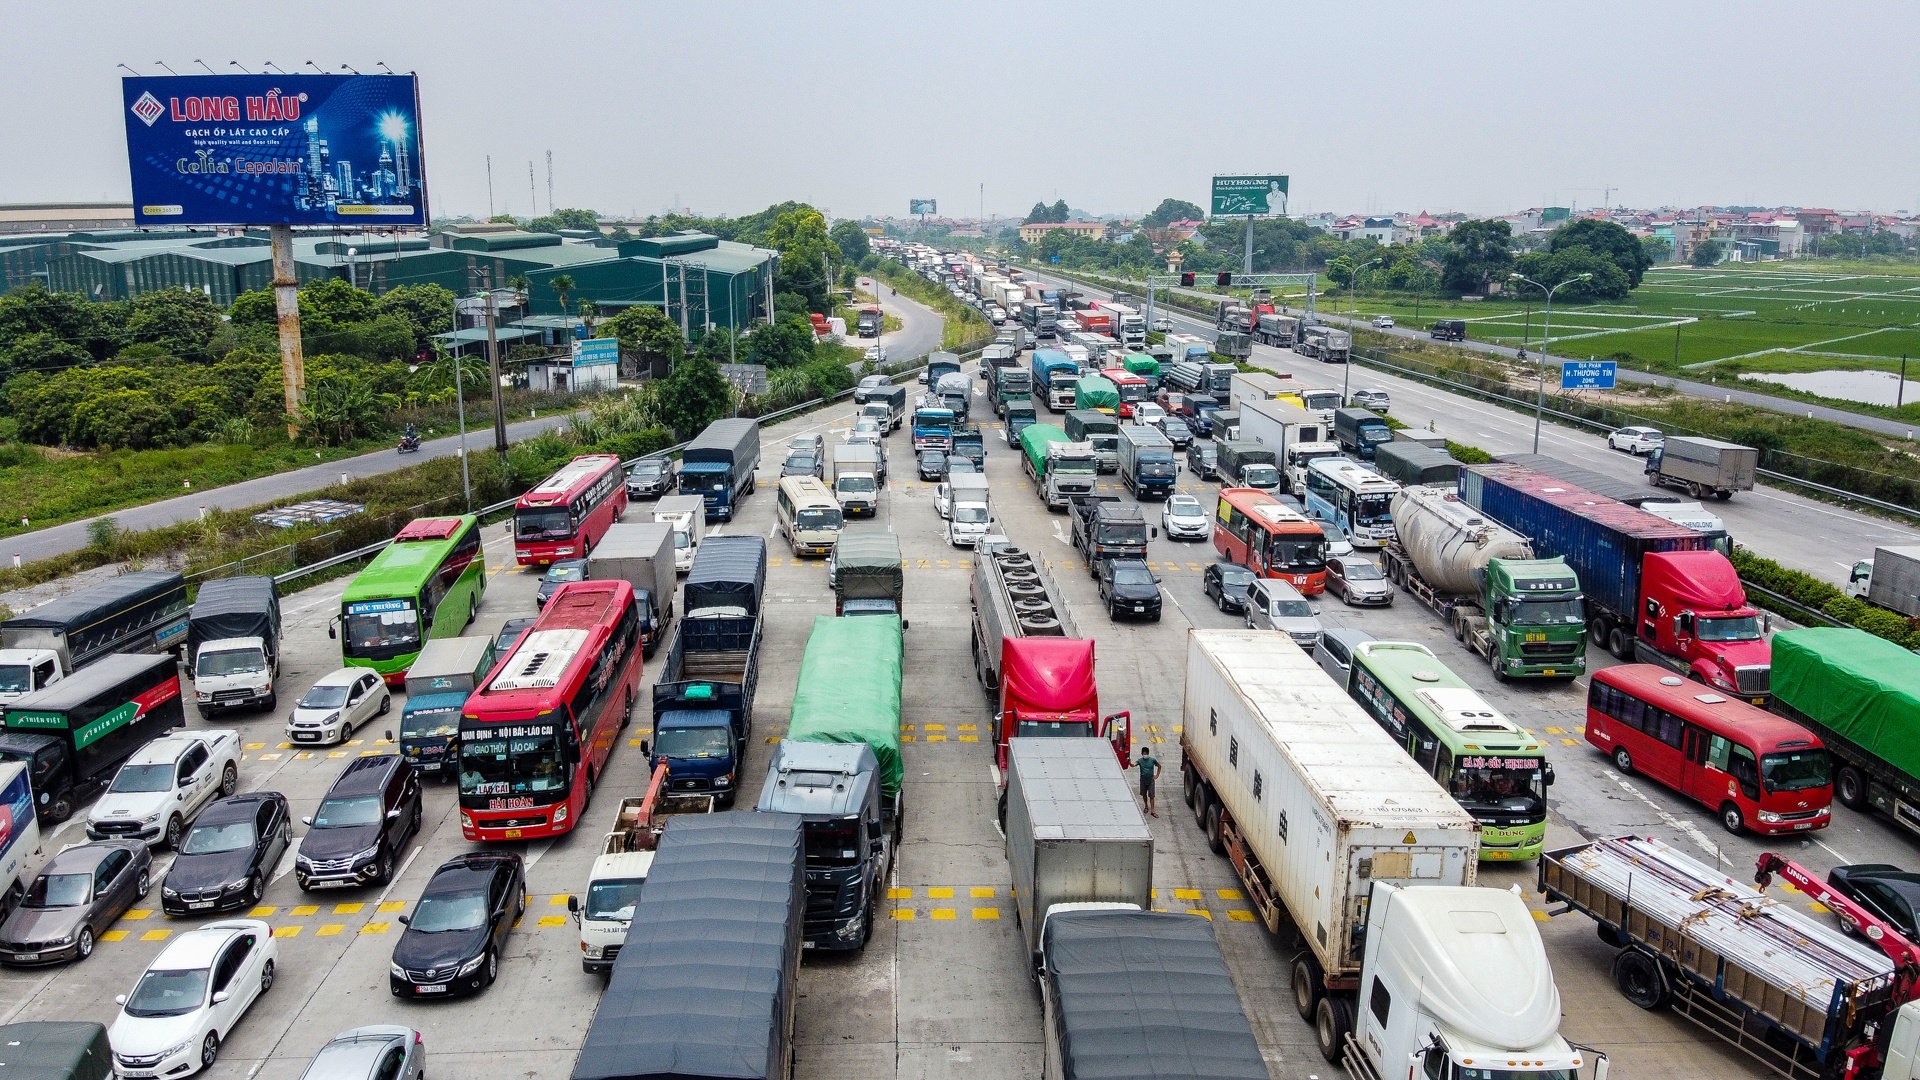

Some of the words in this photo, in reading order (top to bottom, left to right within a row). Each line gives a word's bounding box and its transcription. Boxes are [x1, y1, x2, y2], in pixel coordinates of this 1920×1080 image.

[171, 97, 240, 122] LONG
[246, 87, 300, 122] HẦU
[185, 129, 210, 139] GẠCH
[213, 127, 226, 137] ỐP
[229, 127, 246, 137] LÁT
[249, 129, 268, 137] CAO
[272, 127, 290, 137] CẤP
[176, 153, 229, 174] Celia
[235, 158, 301, 177] Cepolain
[1603, 368, 1612, 376] TÍN
[1293, 576, 1308, 585] 107
[46, 717, 61, 725] VIỆT
[89, 720, 111, 737] THIÊN
[112, 710, 128, 726] VIỆT
[461, 730, 475, 740] NAM
[476, 729, 492, 741] ĐỊNH
[499, 726, 511, 738] NỘI
[541, 725, 553, 735] CAI
[474, 744, 490, 754] GIAO
[523, 742, 534, 751] CAI
[1473, 757, 1485, 769] NỘI
[1505, 759, 1524, 770] THỊNH
[1787, 866, 1809, 885] UNIC
